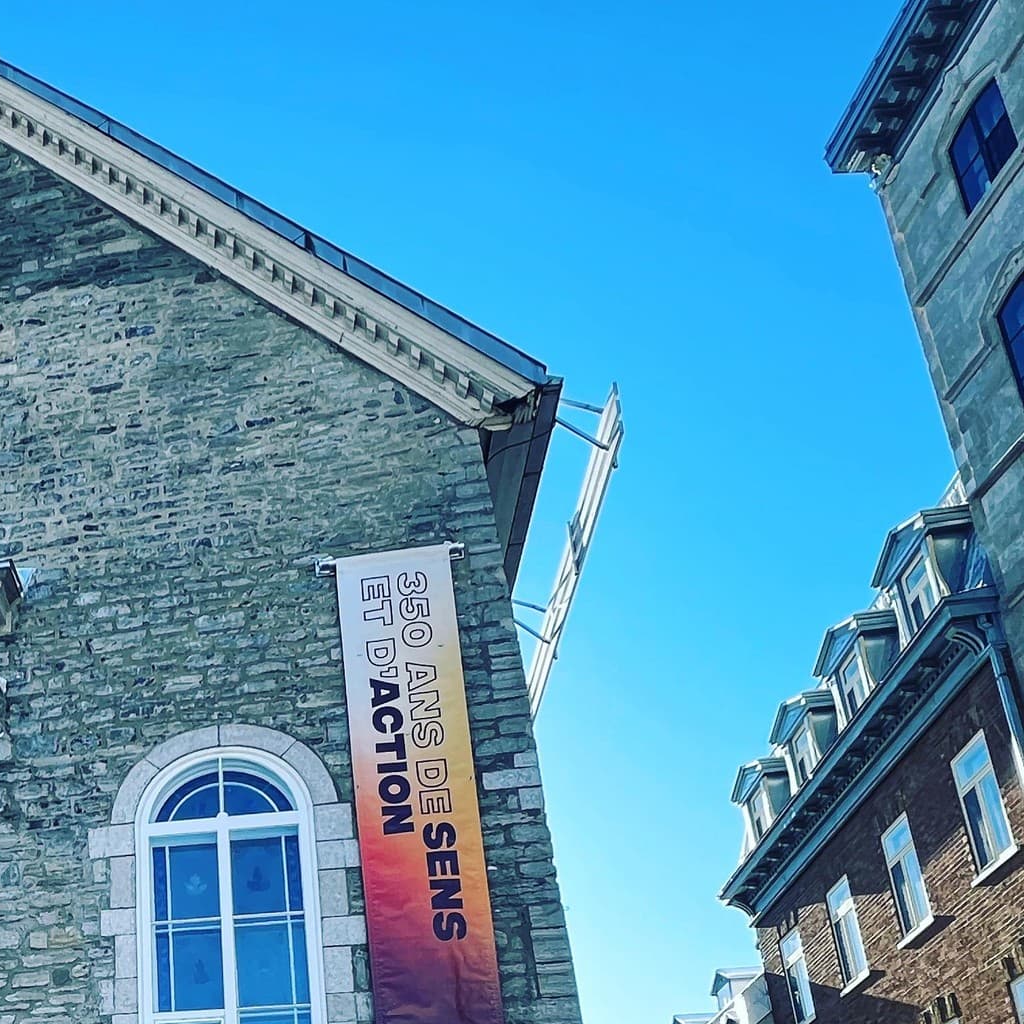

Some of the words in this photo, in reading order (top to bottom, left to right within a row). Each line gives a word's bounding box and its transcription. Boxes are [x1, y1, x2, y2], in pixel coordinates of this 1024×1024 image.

[360, 575, 394, 626] ET
[397, 571, 433, 647] 350
[366, 637, 414, 835] D'ACTION
[406, 662, 445, 749] ANS
[415, 758, 452, 814] DE
[422, 822, 468, 941] SENS
